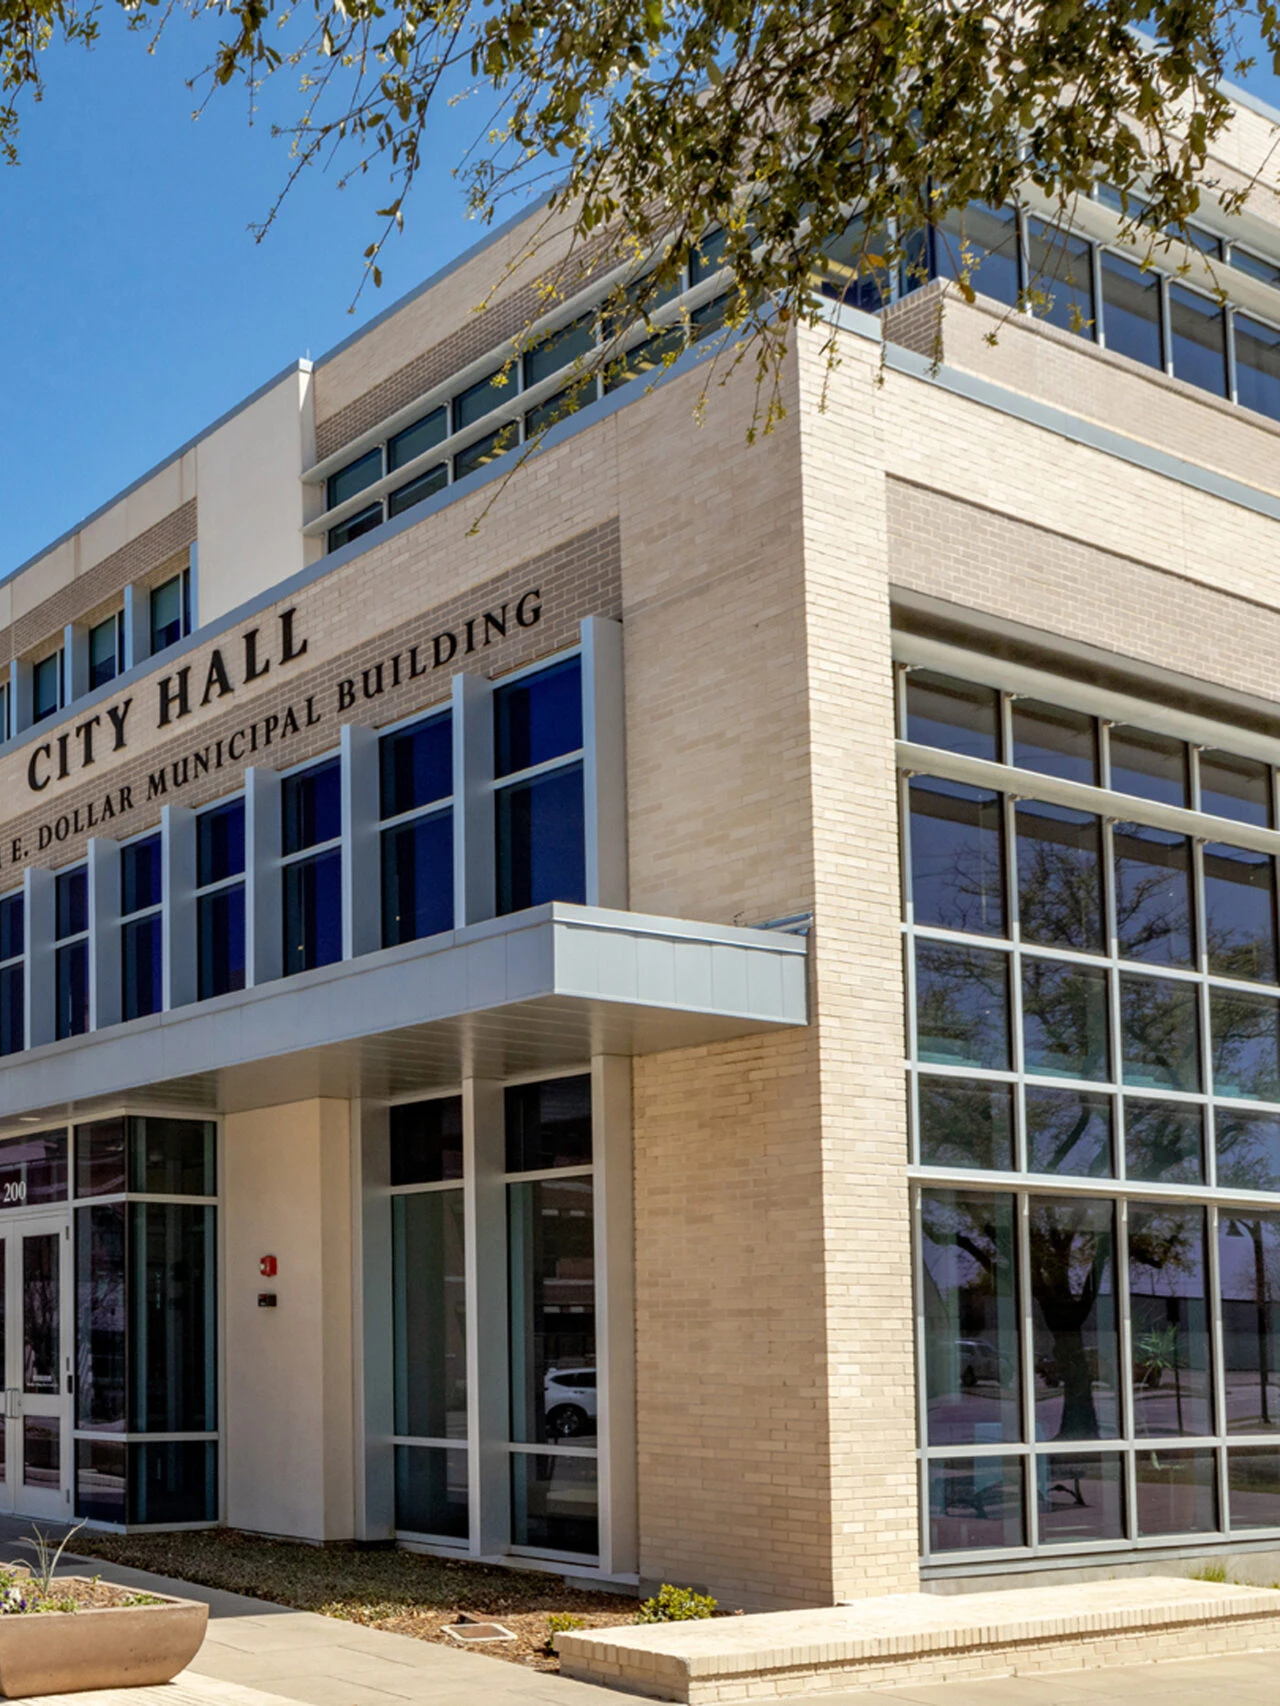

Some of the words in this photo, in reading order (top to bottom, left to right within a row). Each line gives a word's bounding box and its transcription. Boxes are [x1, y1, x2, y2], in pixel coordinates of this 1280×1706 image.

[11, 838, 29, 863] E.
[38, 786, 134, 850] DOLLAR
[146, 696, 321, 801] MUNICIPAL
[336, 589, 542, 712] BUILDING
[28, 698, 133, 792] CITY
[157, 608, 308, 729] HALL
[3, 1181, 27, 1203] 200
